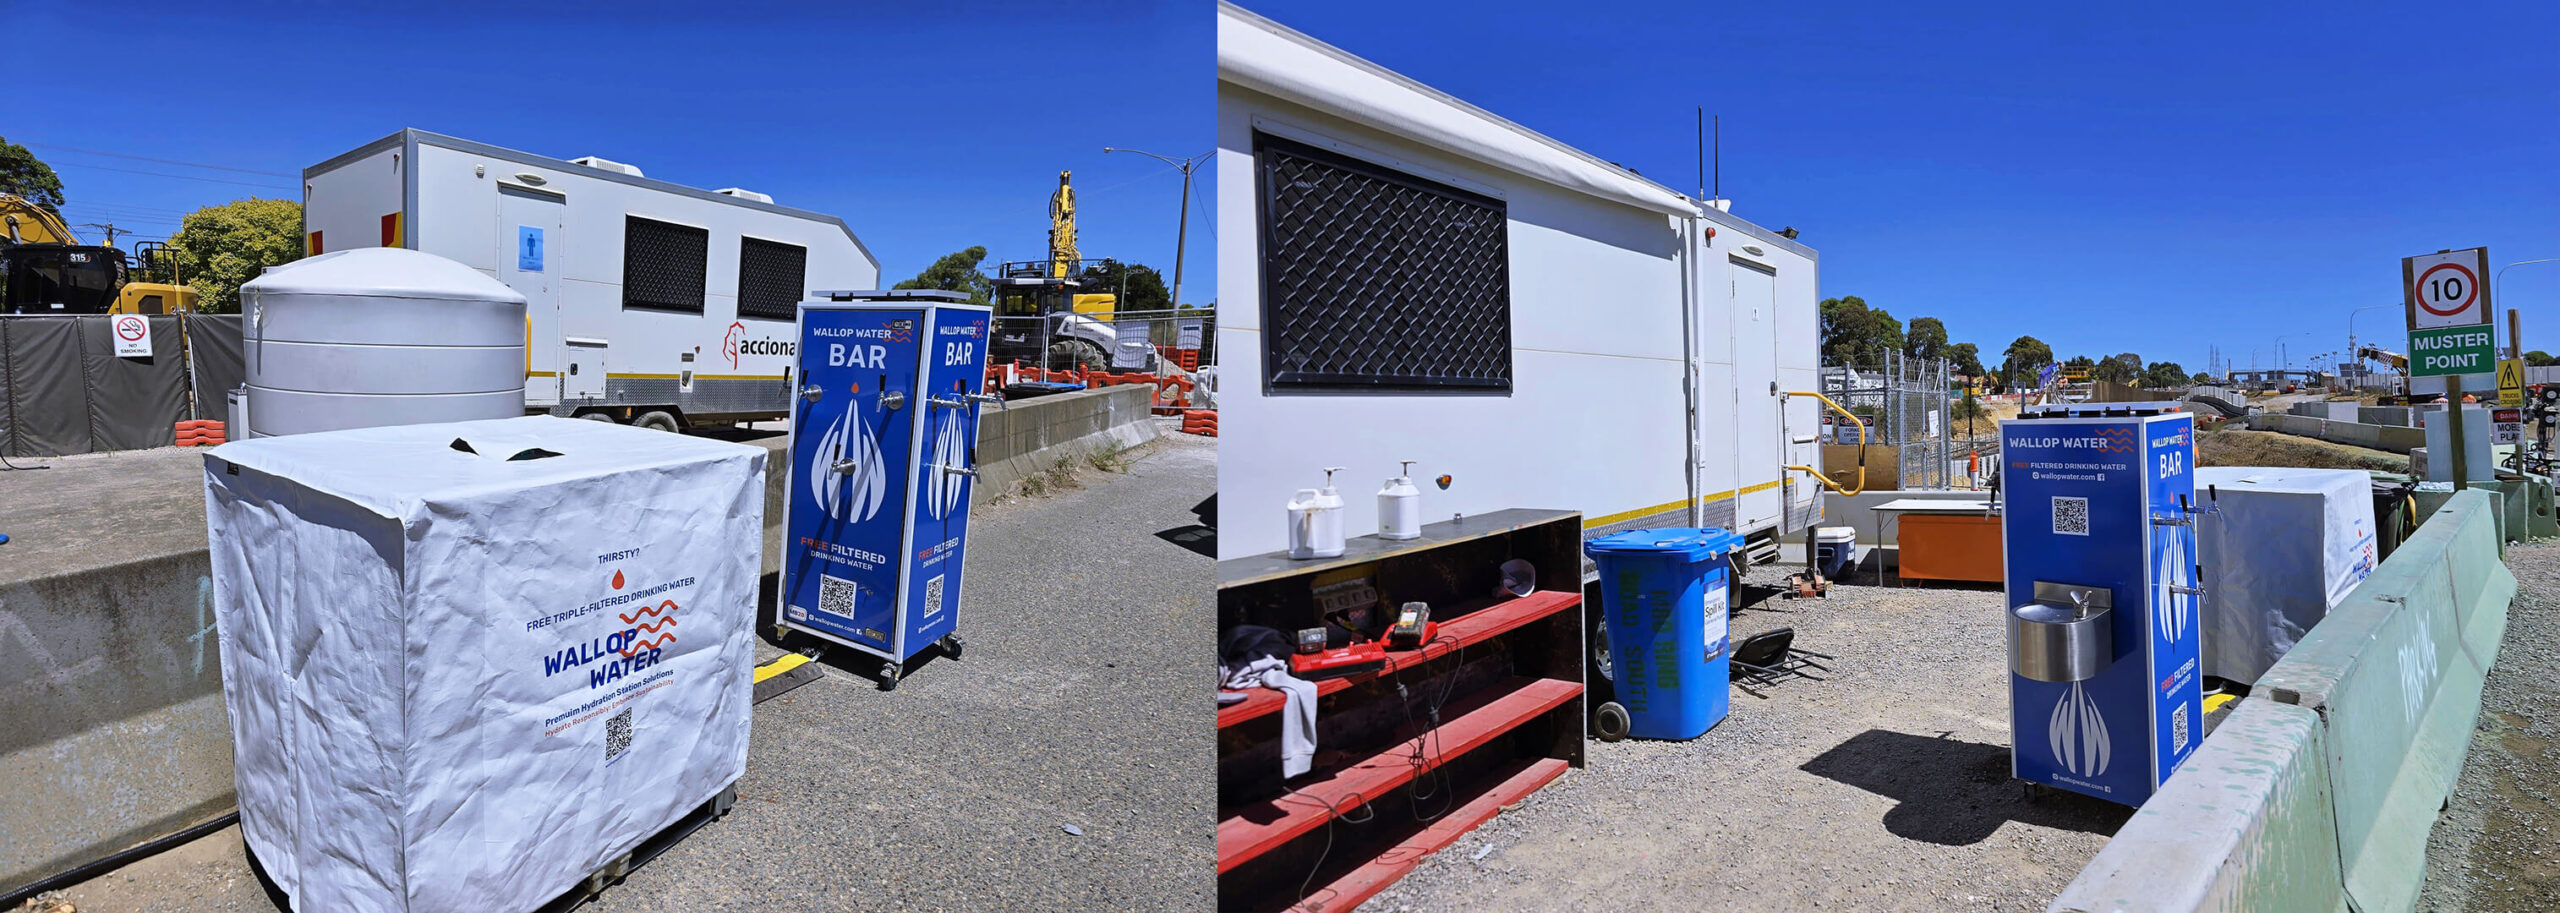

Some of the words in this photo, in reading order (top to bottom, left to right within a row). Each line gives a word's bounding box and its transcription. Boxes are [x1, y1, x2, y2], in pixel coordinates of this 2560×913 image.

[70, 254, 86, 262] 315
[2431, 277, 2462, 301] 10
[813, 328, 853, 337] WALLOP
[855, 329, 891, 339] WATER
[940, 325, 960, 335] WALLOP
[961, 326, 977, 335] WATER
[2414, 333, 2489, 350] MUSTER
[741, 336, 795, 356] acciona
[828, 344, 887, 369] BAR
[945, 342, 973, 366] BAR
[2425, 353, 2480, 369] POINT
[2009, 438, 2060, 448] WALLOP
[2062, 438, 2108, 449] WATER
[2152, 436, 2169, 448] WALLOP
[2169, 434, 2182, 445] WATER
[2040, 472, 2096, 480] wallopwater.com
[2160, 451, 2182, 479] BAR
[598, 548, 640, 564] THIRSTY?
[800, 536, 828, 551] FREE
[831, 543, 886, 565] FILTERED
[810, 550, 846, 565] DRINKING
[847, 560, 873, 571] WATER
[918, 547, 933, 561] FREE
[934, 536, 959, 554] FILTERED
[527, 616, 551, 632] FREE
[553, 594, 630, 624] TRIPLE-FILTERED
[630, 583, 668, 601] DRINKING
[668, 577, 695, 590] WATER
[1705, 603, 1718, 618] Spill
[815, 617, 855, 633] wallopwater.com
[544, 628, 637, 677] WALLOP
[1654, 640, 1680, 689] RING
[590, 647, 662, 689] WATER
[1624, 645, 1649, 712] SOUTH
[2161, 674, 2174, 693] FREE
[2174, 657, 2194, 682] FILTERED
[545, 708, 580, 728] Premuim
[581, 693, 616, 712] Hydration
[616, 681, 642, 696] Station
[642, 669, 674, 685] Solutions
[545, 722, 571, 737] Hydrate
[635, 679, 674, 697] Sustainability
